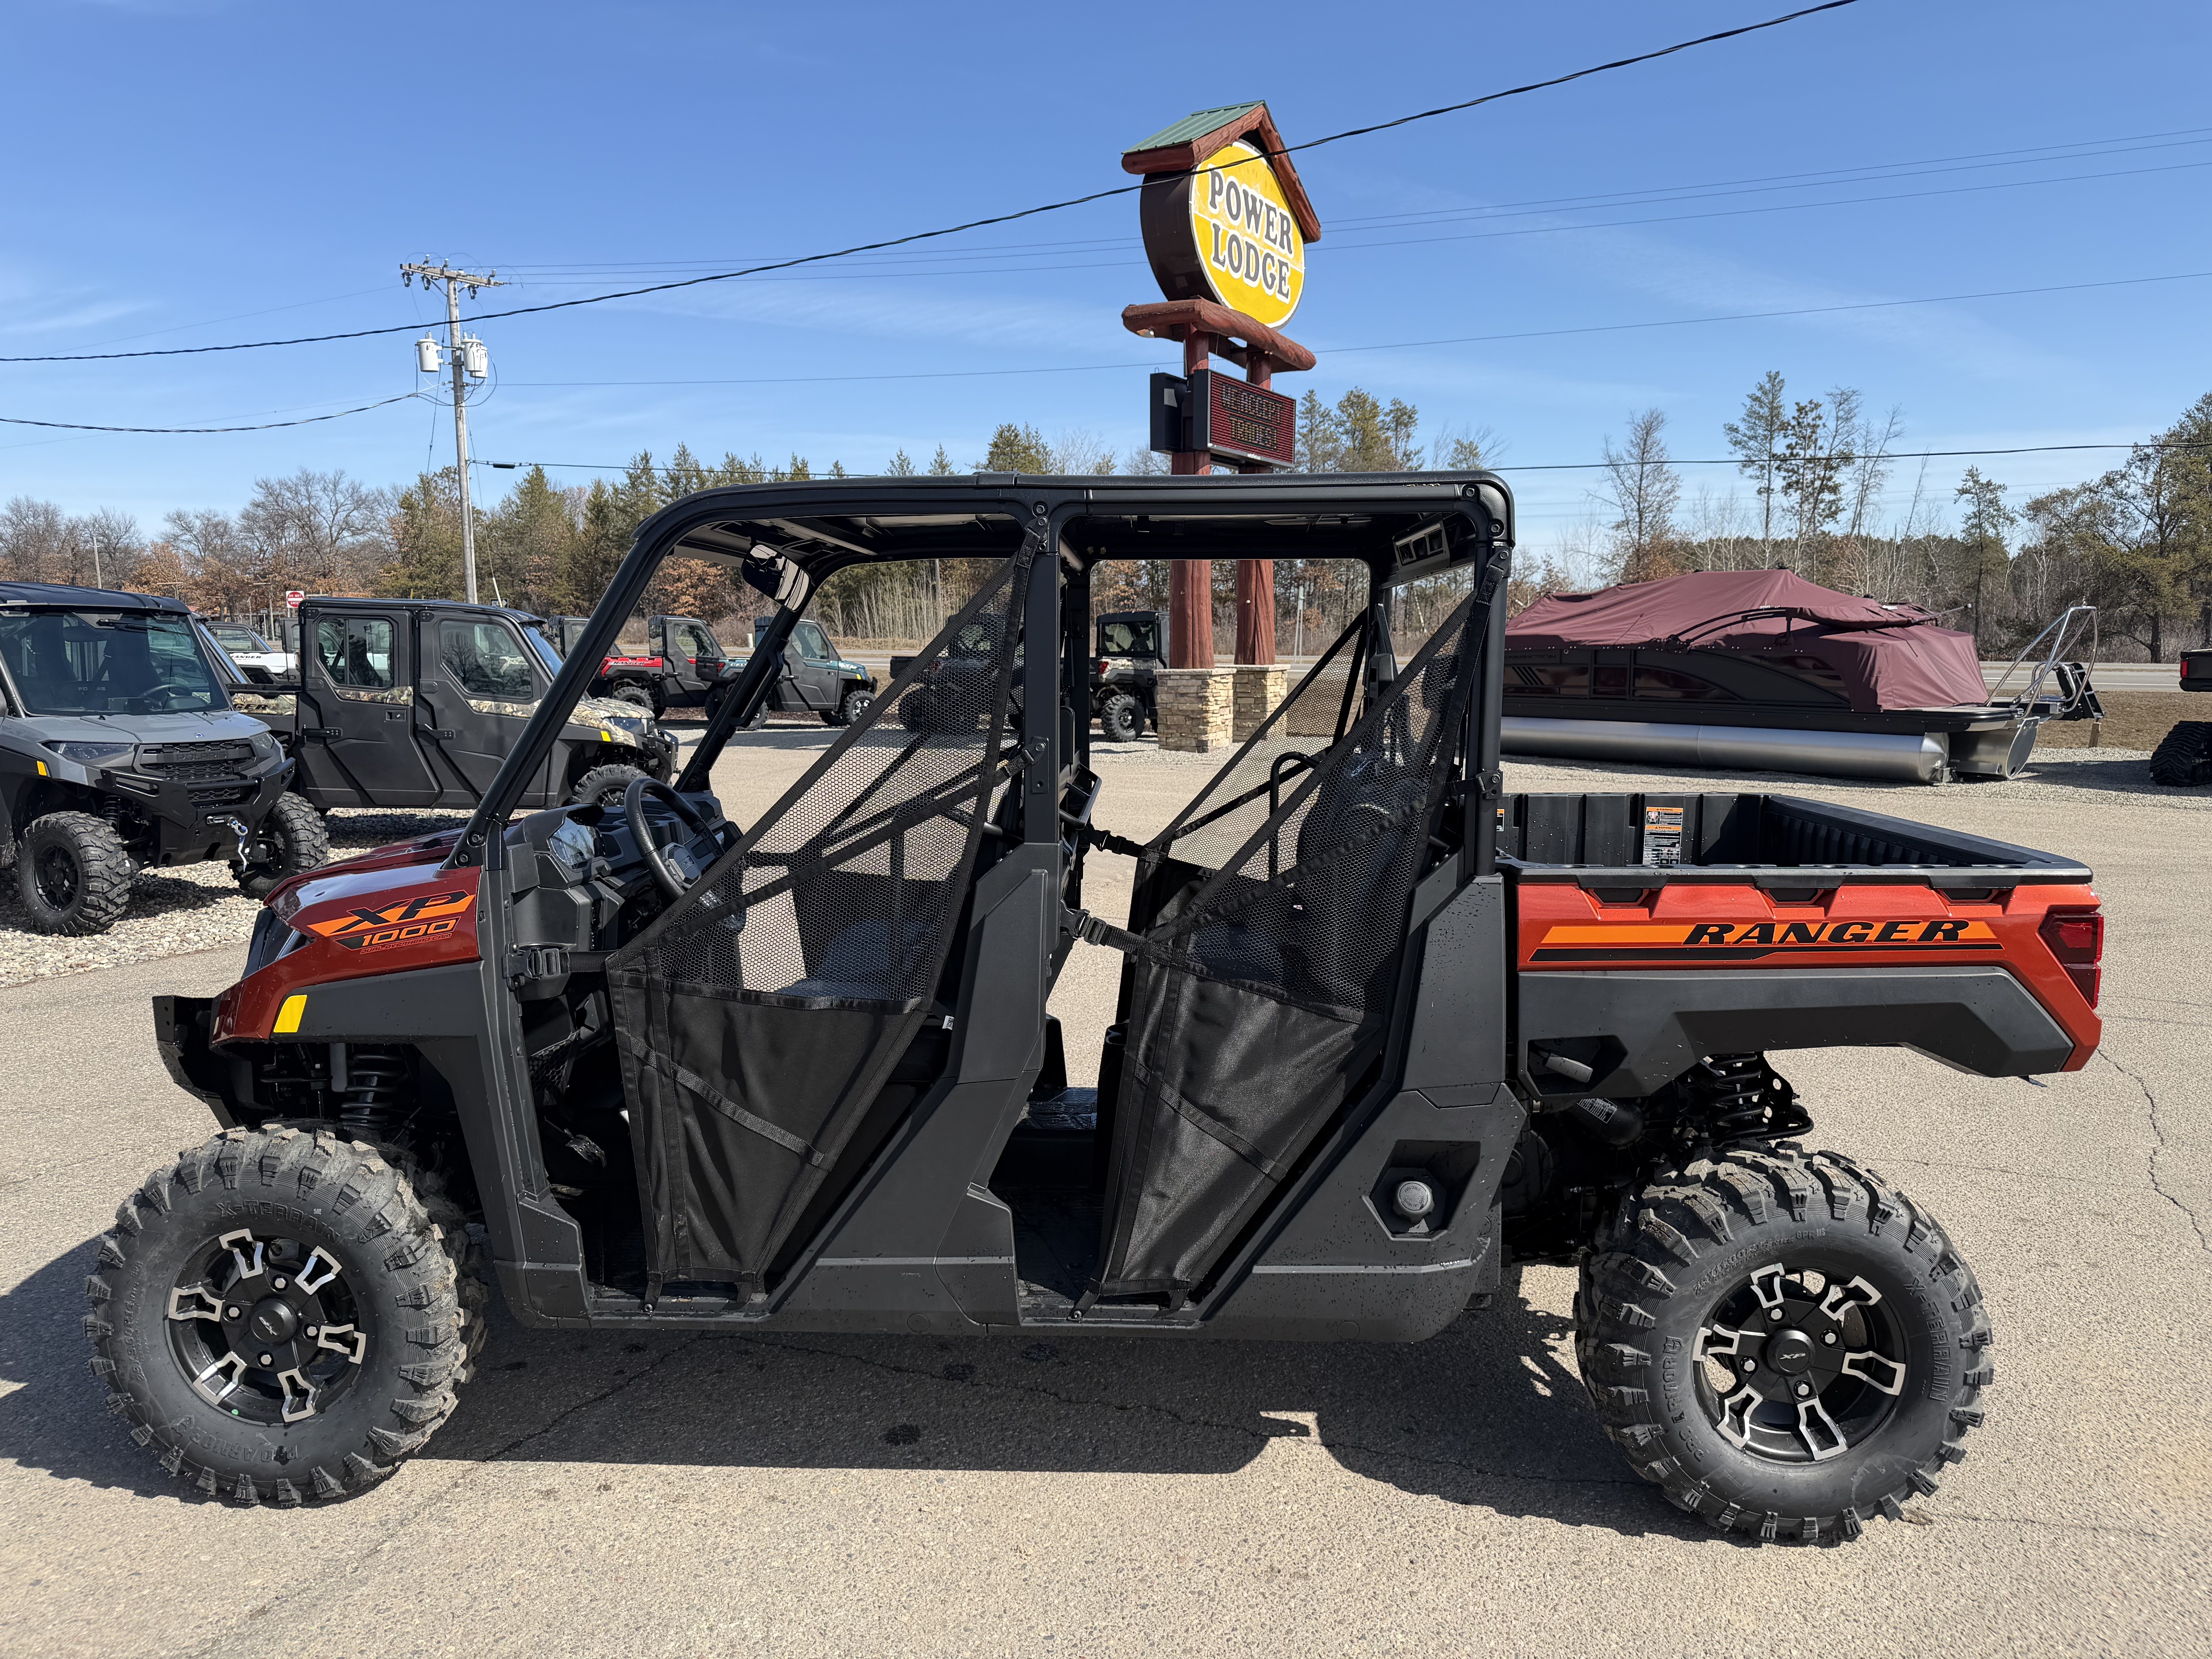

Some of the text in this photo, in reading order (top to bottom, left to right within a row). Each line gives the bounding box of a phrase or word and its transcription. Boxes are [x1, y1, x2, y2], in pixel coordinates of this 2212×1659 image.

[1209, 170, 1293, 255] POWER
[1212, 222, 1290, 299] LODGE
[177, 751, 228, 761] POLARIS
[330, 889, 470, 934] XP
[362, 920, 456, 946] 1000
[385, 938, 430, 949] OVERHEAD
[1682, 920, 1970, 945] RANGER
[216, 1200, 342, 1246] X-TERRAIN
[1795, 1231, 1814, 1240] 8PR
[259, 1316, 277, 1335] XP
[1903, 1277, 1951, 1401] X-TERRAIN
[1662, 1356, 1686, 1424] ARMOR
[189, 1427, 254, 1462] ARMOR
